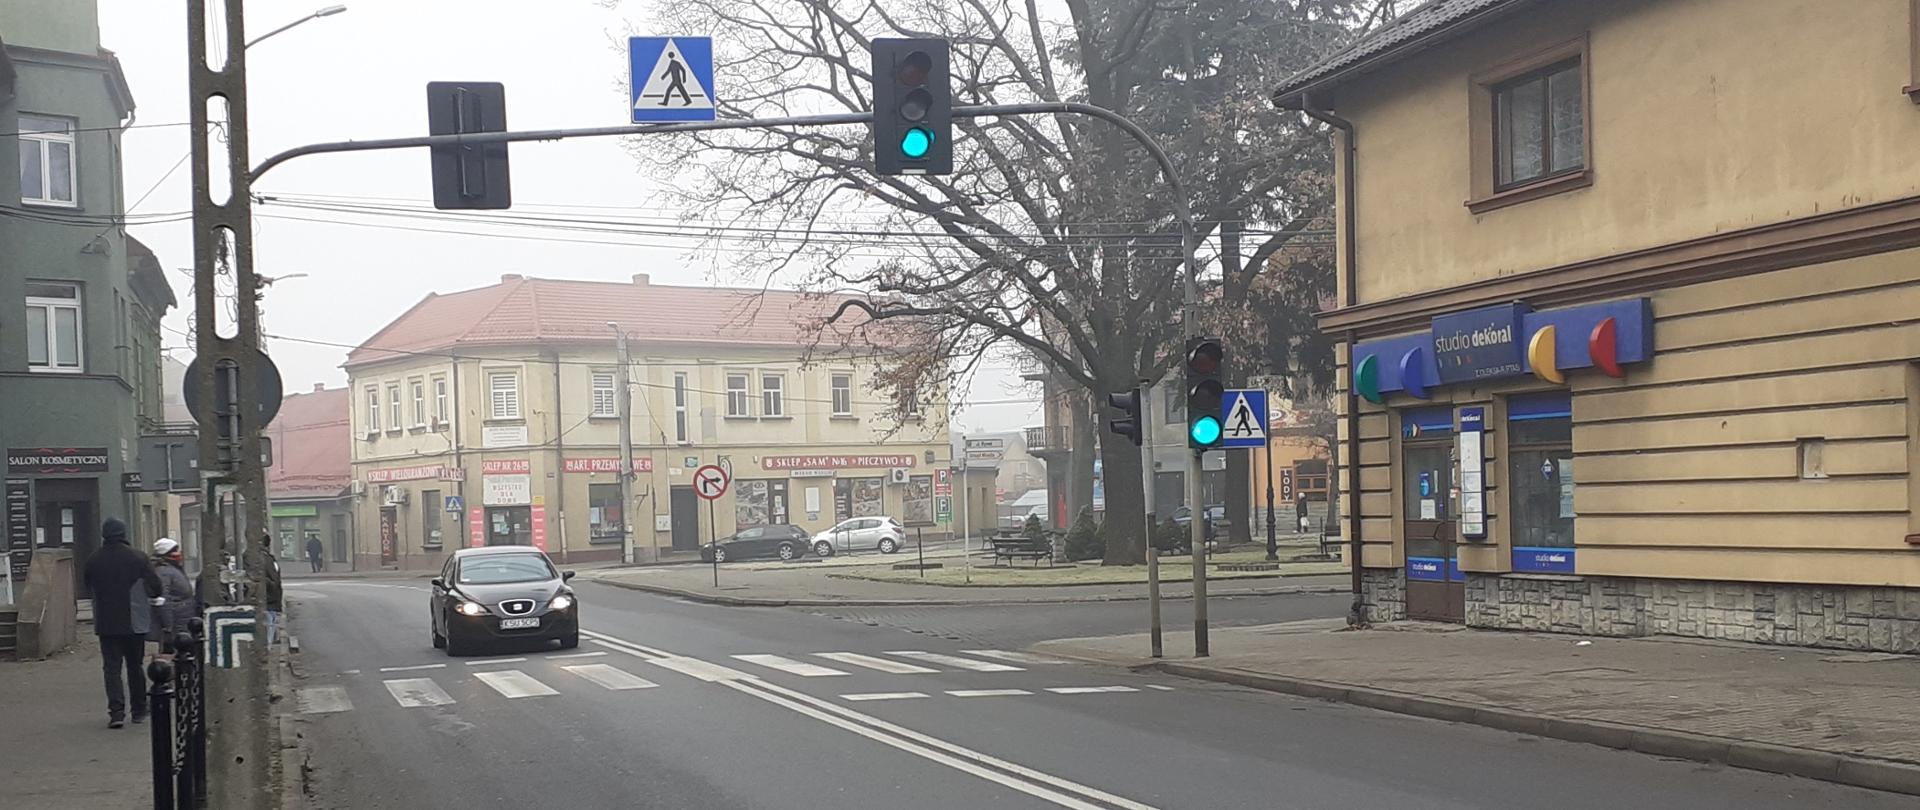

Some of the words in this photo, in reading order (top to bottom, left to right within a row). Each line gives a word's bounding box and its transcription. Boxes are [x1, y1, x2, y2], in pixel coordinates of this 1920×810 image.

[1435, 330, 1470, 353] studio
[1472, 323, 1512, 347] dekoral
[9, 456, 39, 465] SALON
[41, 456, 107, 465] KOSMETYCZNY
[482, 461, 502, 472] SKLEP
[573, 459, 590, 471] ART.
[776, 457, 801, 467] SKLEP
[857, 455, 898, 465] PIECZYWO
